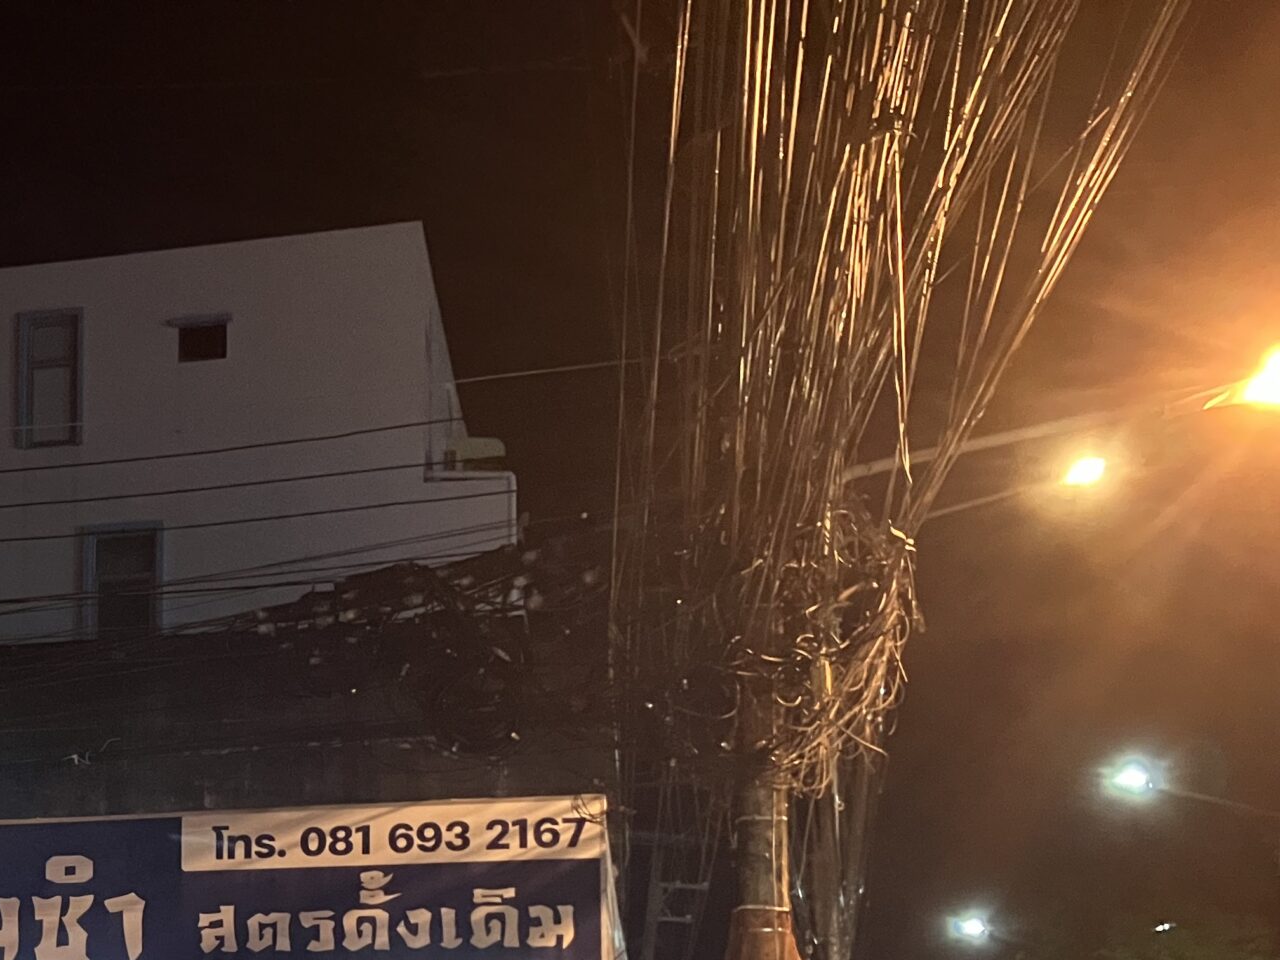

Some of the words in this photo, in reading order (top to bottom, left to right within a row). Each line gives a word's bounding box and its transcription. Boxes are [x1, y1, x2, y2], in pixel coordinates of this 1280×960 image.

[212, 825, 287, 860] โทร.
[299, 824, 371, 857] 081
[388, 820, 471, 854] 693
[485, 816, 588, 850] 2167
